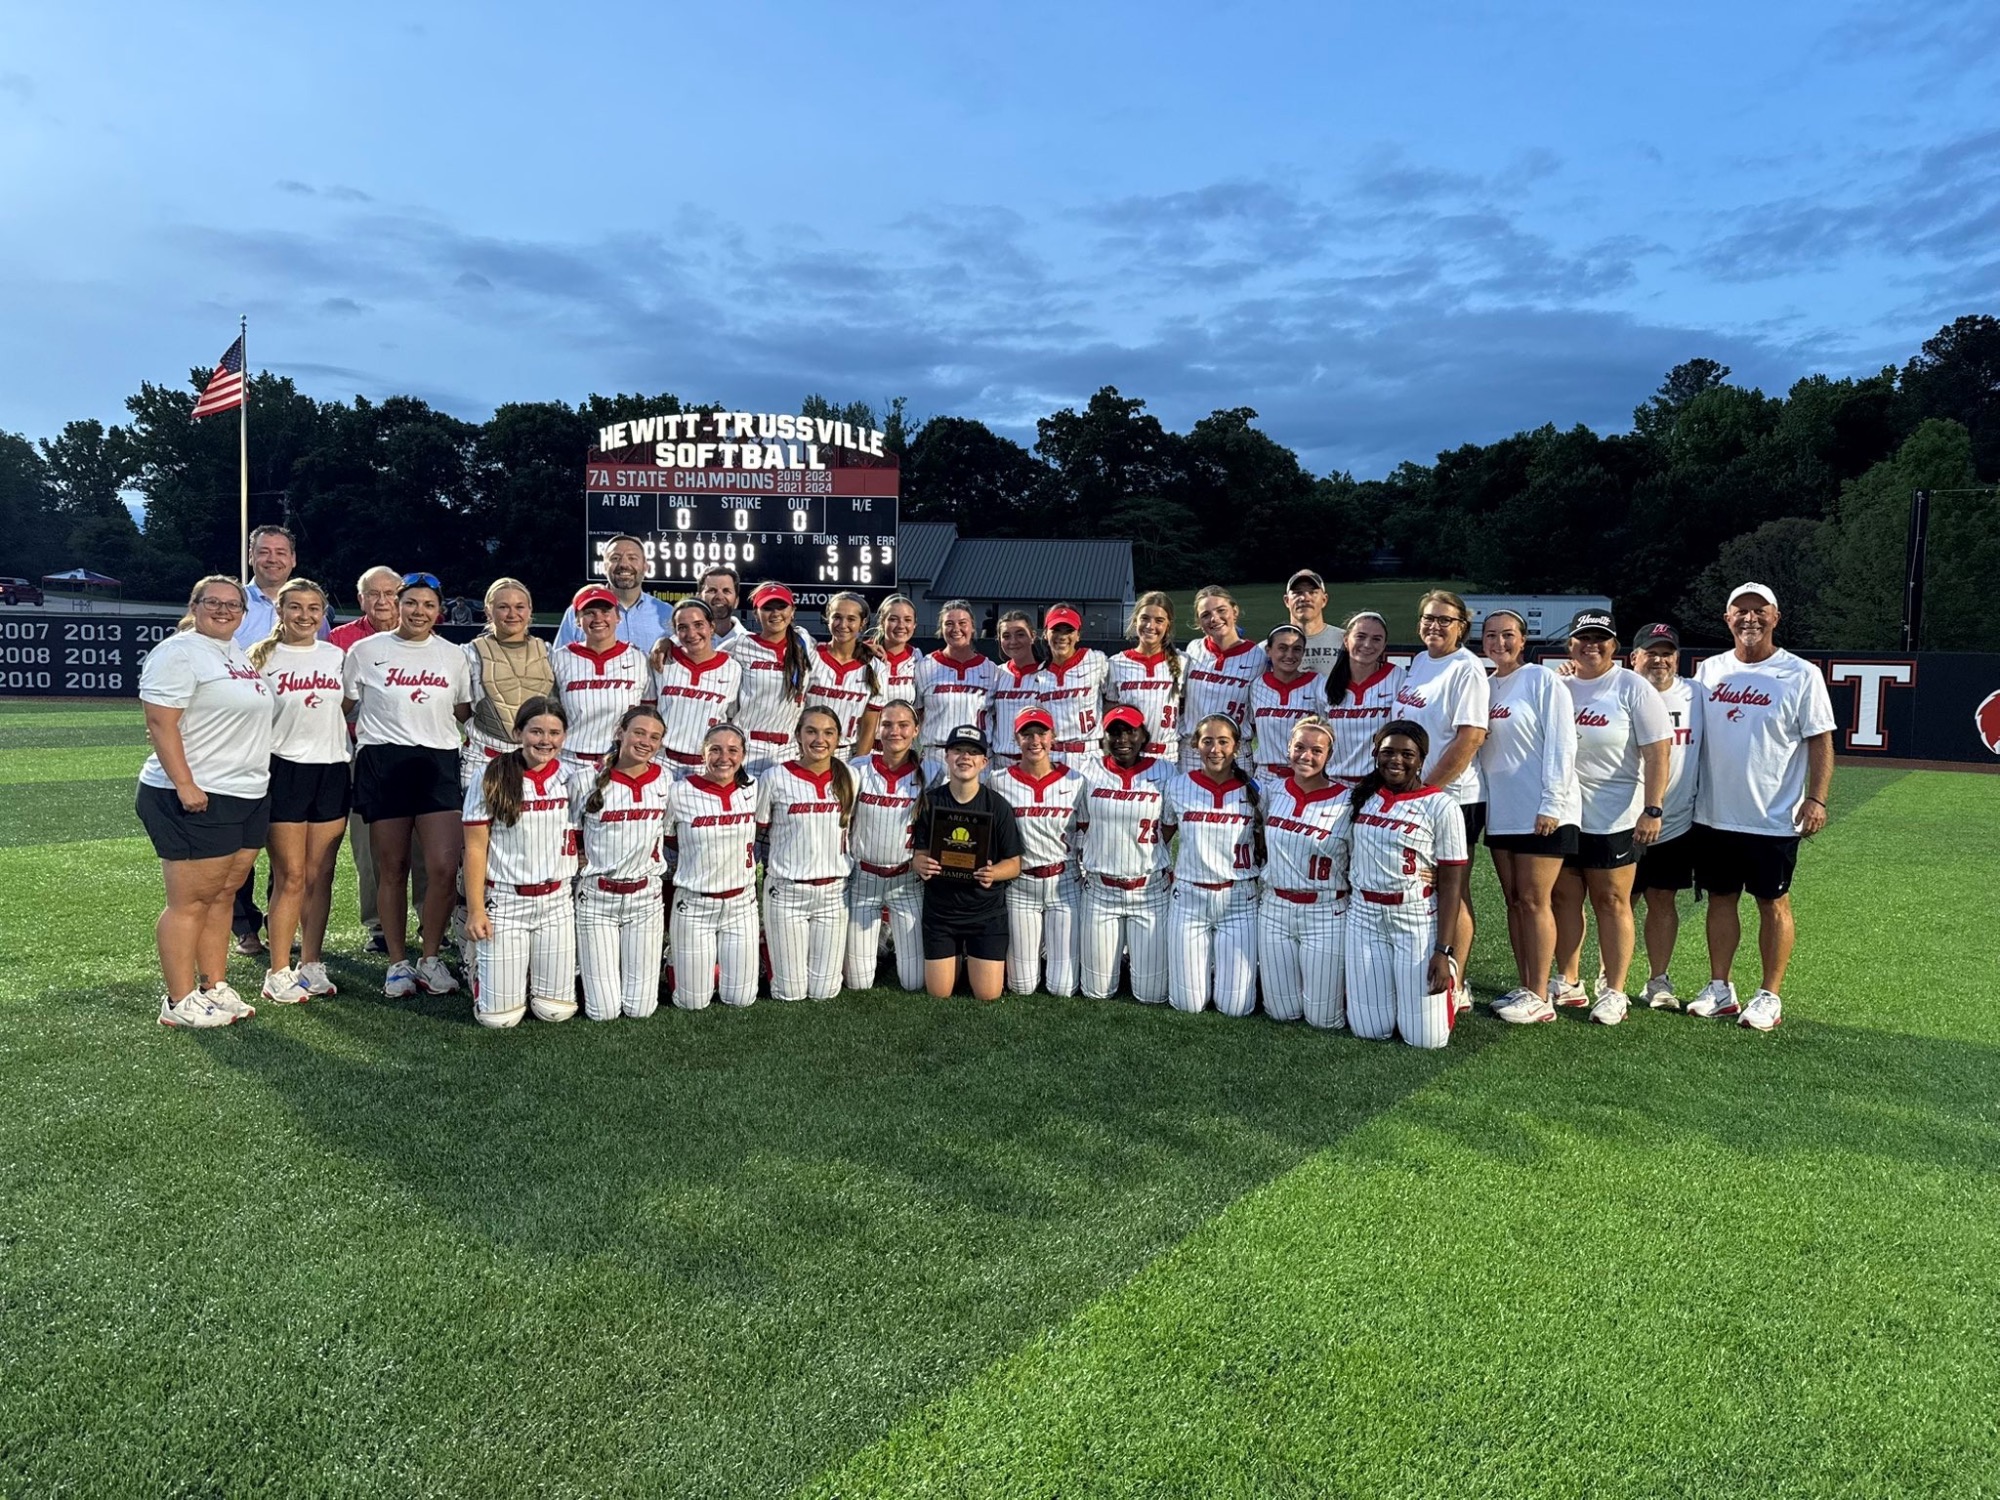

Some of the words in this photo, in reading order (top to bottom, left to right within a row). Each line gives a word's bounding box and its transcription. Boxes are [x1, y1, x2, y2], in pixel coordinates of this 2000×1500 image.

[655, 443, 826, 470] SOFTBALL
[588, 470, 610, 487] 7A
[616, 470, 667, 488] STATE
[674, 471, 774, 490] CHAMPIONS
[777, 470, 802, 481] 2019
[805, 471, 832, 482] 2023
[777, 482, 802, 493] 2021
[805, 482, 832, 493] 2024
[601, 495, 618, 507] AT
[620, 495, 641, 507] BAT
[669, 496, 697, 508] BALL
[721, 497, 761, 510] STRIKE
[787, 497, 811, 511] OUT
[852, 498, 872, 512] H/E
[676, 508, 691, 530] 0
[734, 508, 749, 531] 0
[793, 510, 807, 532] 0
[647, 532, 652, 541] 1
[661, 532, 667, 541] 2
[677, 532, 683, 541] 3
[696, 533, 702, 542] 4
[711, 533, 717, 542] 5
[726, 533, 732, 543] 6
[746, 533, 752, 543] 7
[761, 534, 767, 544] 8
[776, 535, 782, 544] 9
[793, 535, 803, 545] 10
[813, 535, 839, 545] RUNS
[848, 535, 870, 546] HITS
[876, 536, 896, 546] ERR
[659, 541, 671, 560] 5
[674, 541, 687, 560] 0
[693, 541, 705, 561] 0
[708, 542, 721, 561] 0
[724, 542, 736, 561] 0
[742, 543, 755, 562] 0
[826, 544, 839, 564] 5
[860, 545, 872, 564] 6
[881, 546, 893, 565] 3
[665, 562, 671, 578] 1
[681, 562, 687, 578] 1
[819, 565, 839, 581] 14
[852, 565, 872, 583] 16
[1576, 614, 1611, 628] Hewitt
[64, 624, 122, 642] 2013
[65, 648, 122, 666] 2014
[65, 672, 123, 690] 2018
[276, 670, 341, 695] Huskies
[384, 667, 449, 690] Huskies
[565, 679, 636, 693] HEWITT
[1189, 669, 1250, 689] HEWITT
[661, 685, 726, 704] HEWITT
[808, 684, 867, 702] HEWITT
[933, 684, 989, 696] HEWITT
[1709, 682, 1771, 706] Huskies
[1079, 709, 1097, 734] 15
[1091, 788, 1160, 803] HEWITT
[1182, 811, 1253, 826] HEWITT
[1308, 854, 1332, 881] 18
[1402, 847, 1417, 875] 3
